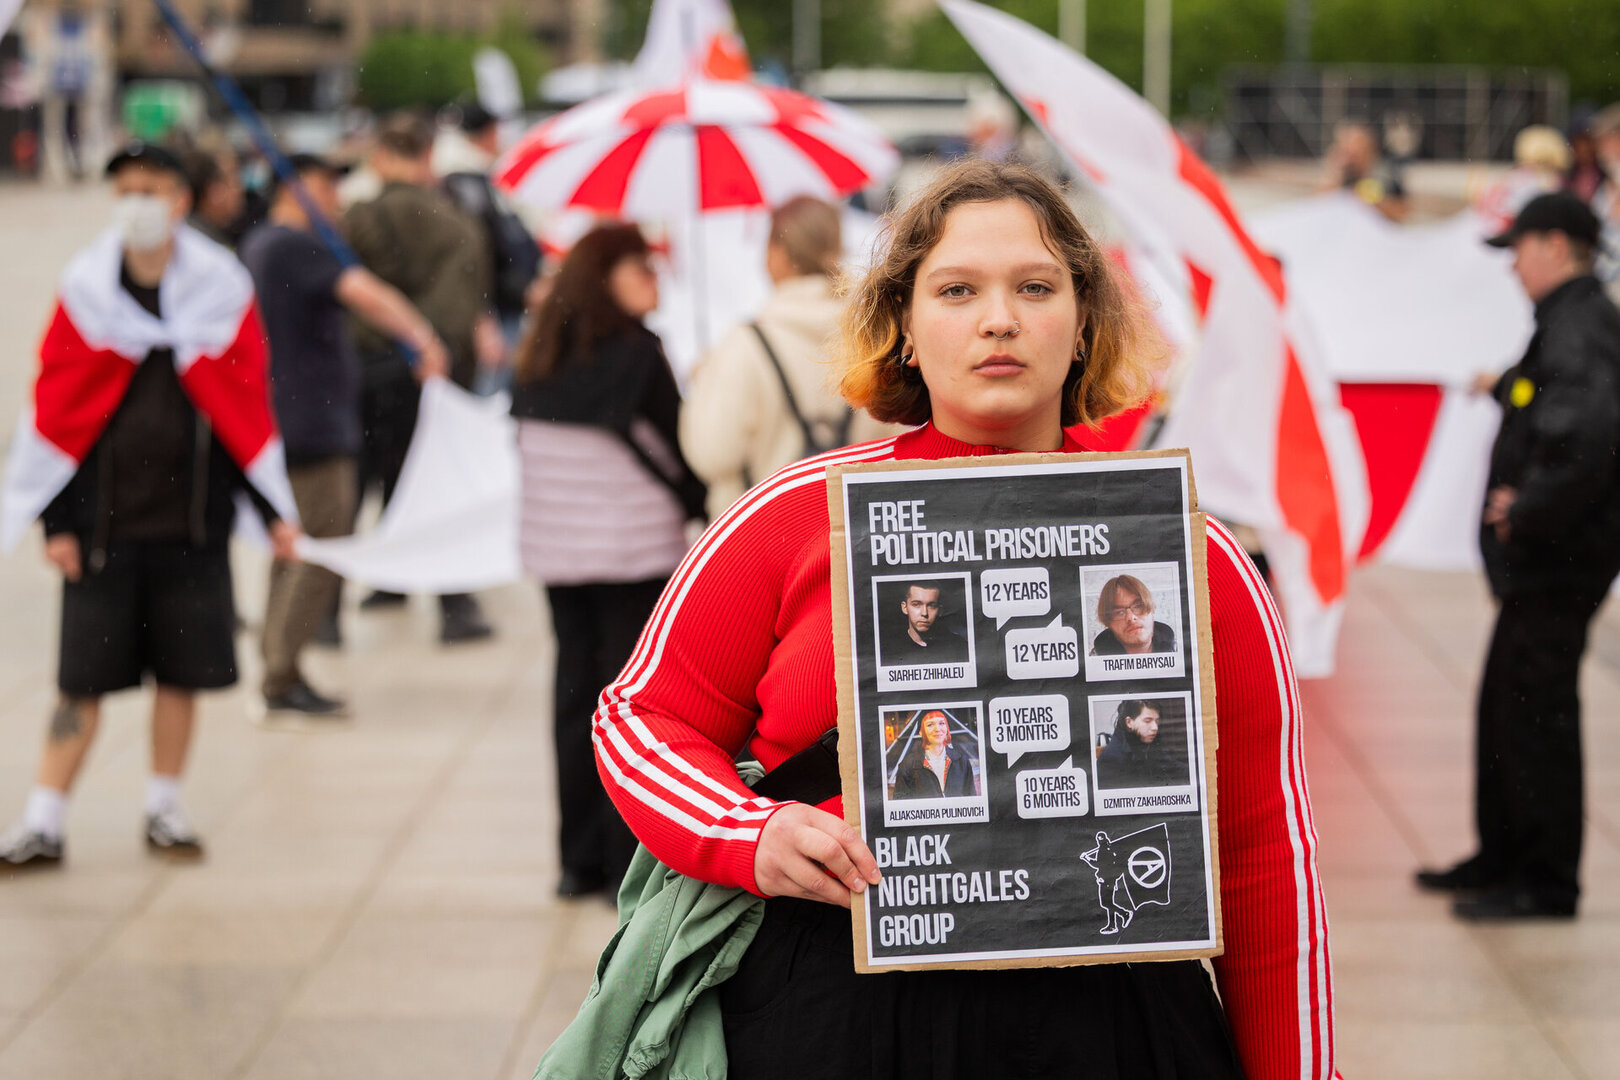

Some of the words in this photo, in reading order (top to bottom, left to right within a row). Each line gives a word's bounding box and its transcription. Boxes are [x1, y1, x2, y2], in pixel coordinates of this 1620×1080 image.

[868, 499, 927, 533] FREE
[870, 530, 983, 566] POLITICAL
[985, 523, 1110, 560] PRISONERS
[984, 583, 1001, 602] 12
[1003, 581, 1048, 601] YEARS
[1012, 644, 1029, 663] 12
[1031, 642, 1076, 662] YEARS
[1103, 658, 1135, 671] TRAFIM
[1136, 656, 1175, 670] BARYSAU
[888, 669, 922, 682] SIARHEI
[923, 667, 964, 680] ZHIHALEU
[996, 708, 1011, 725] 10
[1013, 706, 1053, 724] YEARS
[996, 726, 1004, 743] 3
[1007, 723, 1058, 742] MONTHS
[1024, 777, 1037, 793] 10
[1039, 775, 1076, 792] YEARS
[1023, 793, 1031, 809] 6
[1033, 791, 1080, 809] MONTHS
[1103, 797, 1136, 809] DZMITRY
[1137, 794, 1192, 807] ZAKHAROSHKA
[889, 808, 940, 821] ALIAKSANDRA
[941, 806, 985, 819] PULINOVICH
[875, 834, 952, 868] BLACK
[878, 869, 1030, 908] NIGHTGALES
[879, 912, 955, 947] GROUP
